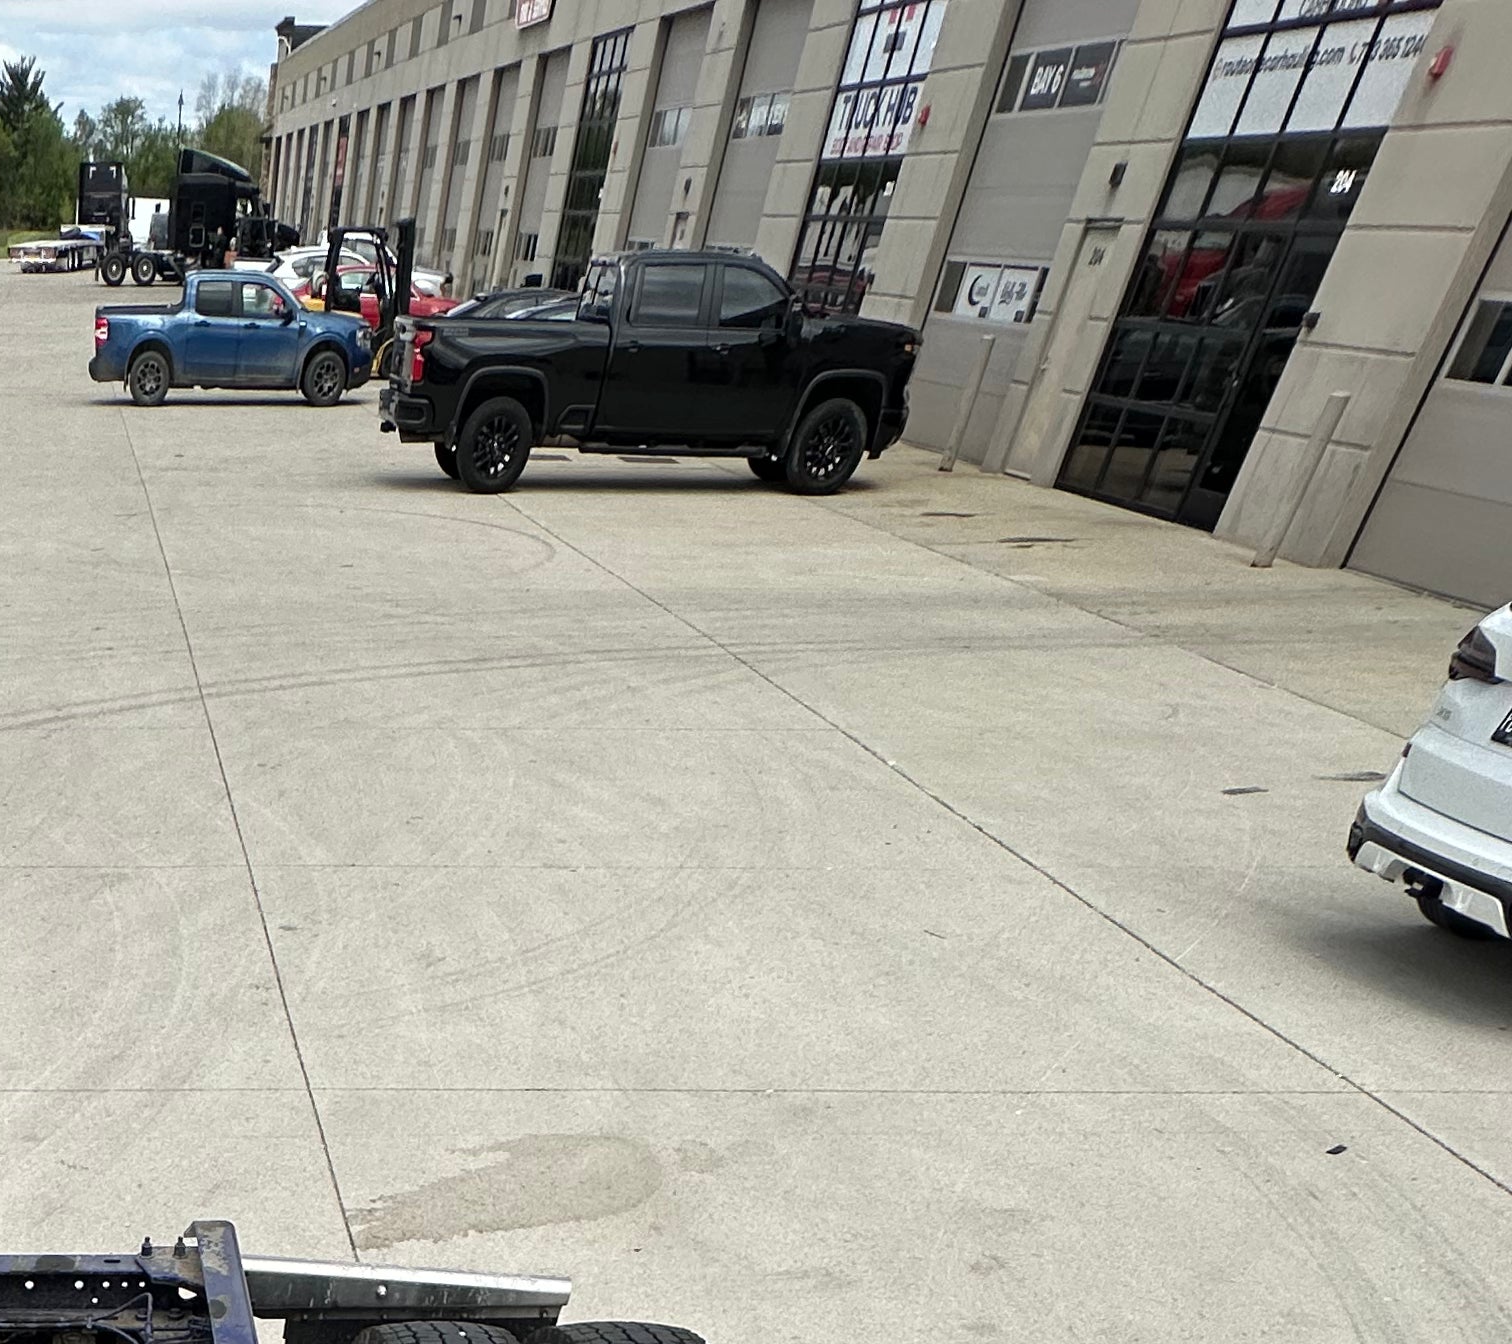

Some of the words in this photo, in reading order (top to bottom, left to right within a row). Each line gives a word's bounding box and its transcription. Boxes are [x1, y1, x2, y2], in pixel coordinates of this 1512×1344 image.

[1356, 37, 1380, 65] 73
[1030, 64, 1058, 95] BAY
[1051, 64, 1065, 95] 6
